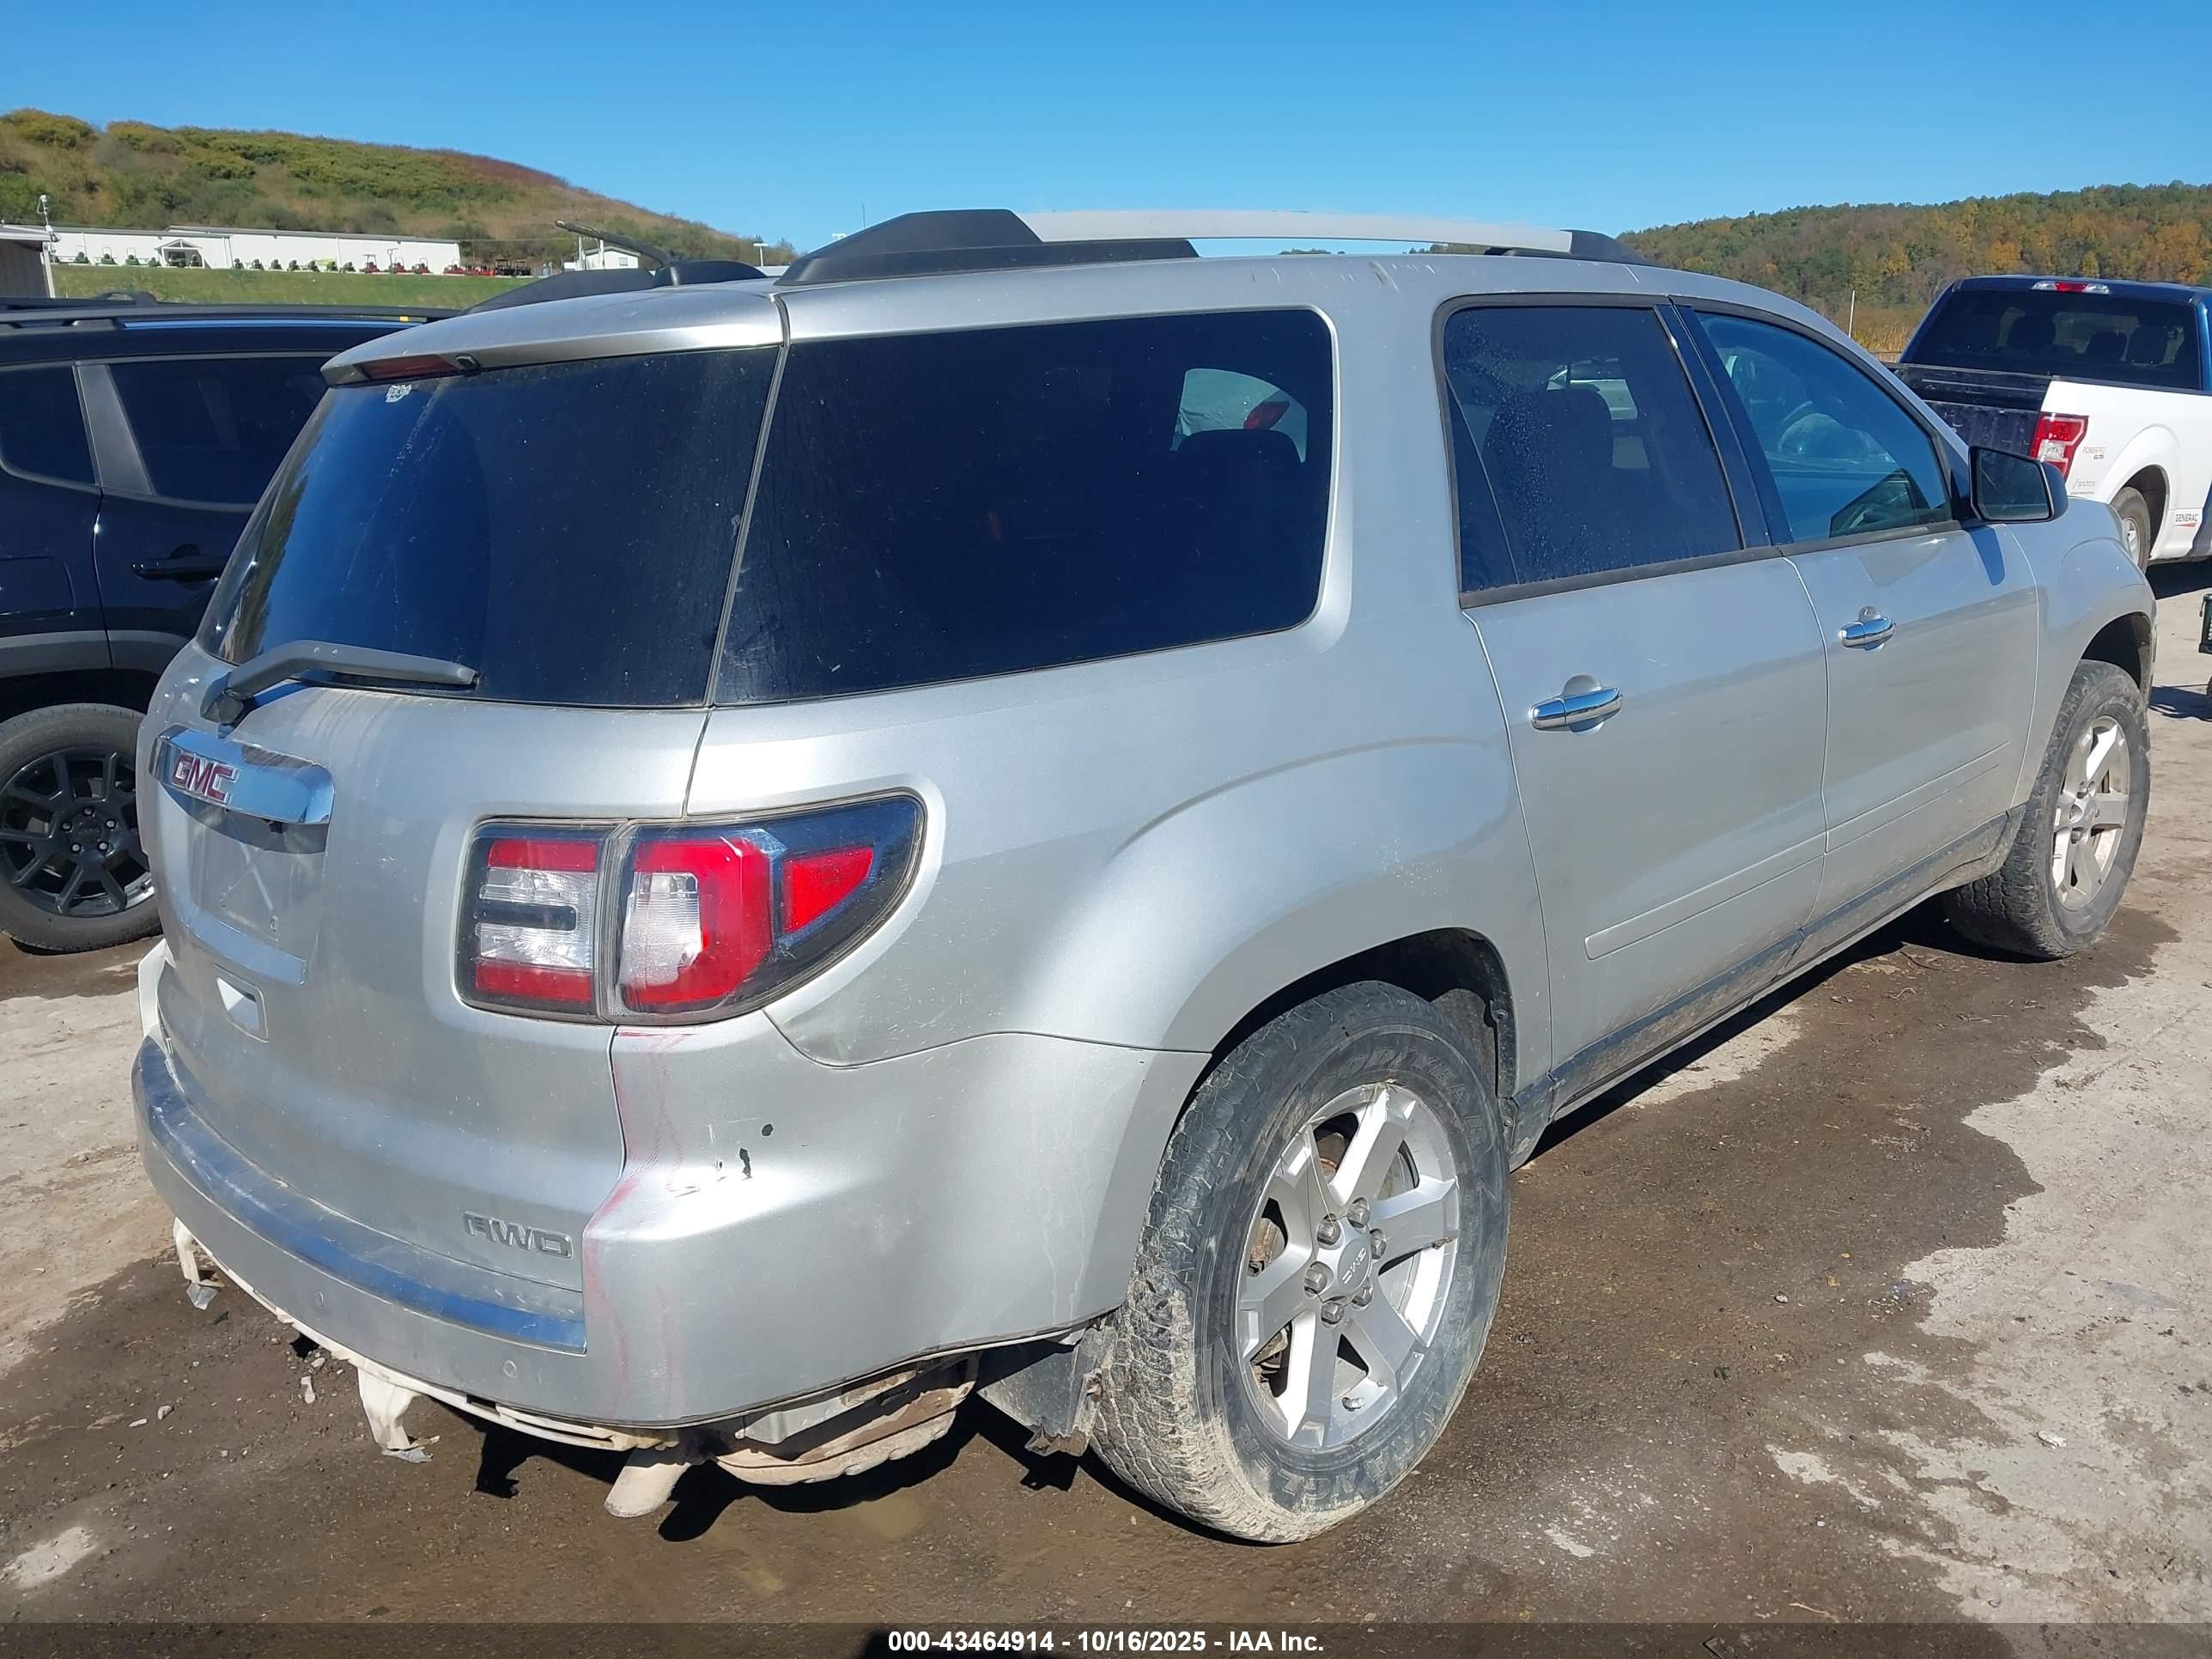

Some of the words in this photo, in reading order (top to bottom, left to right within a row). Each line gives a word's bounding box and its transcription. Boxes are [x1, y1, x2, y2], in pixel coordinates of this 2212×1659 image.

[2175, 513, 2199, 523] GENERAC
[173, 752, 240, 805] GMC
[462, 1210, 574, 1259] AWD
[1341, 1247, 1367, 1285] GMC
